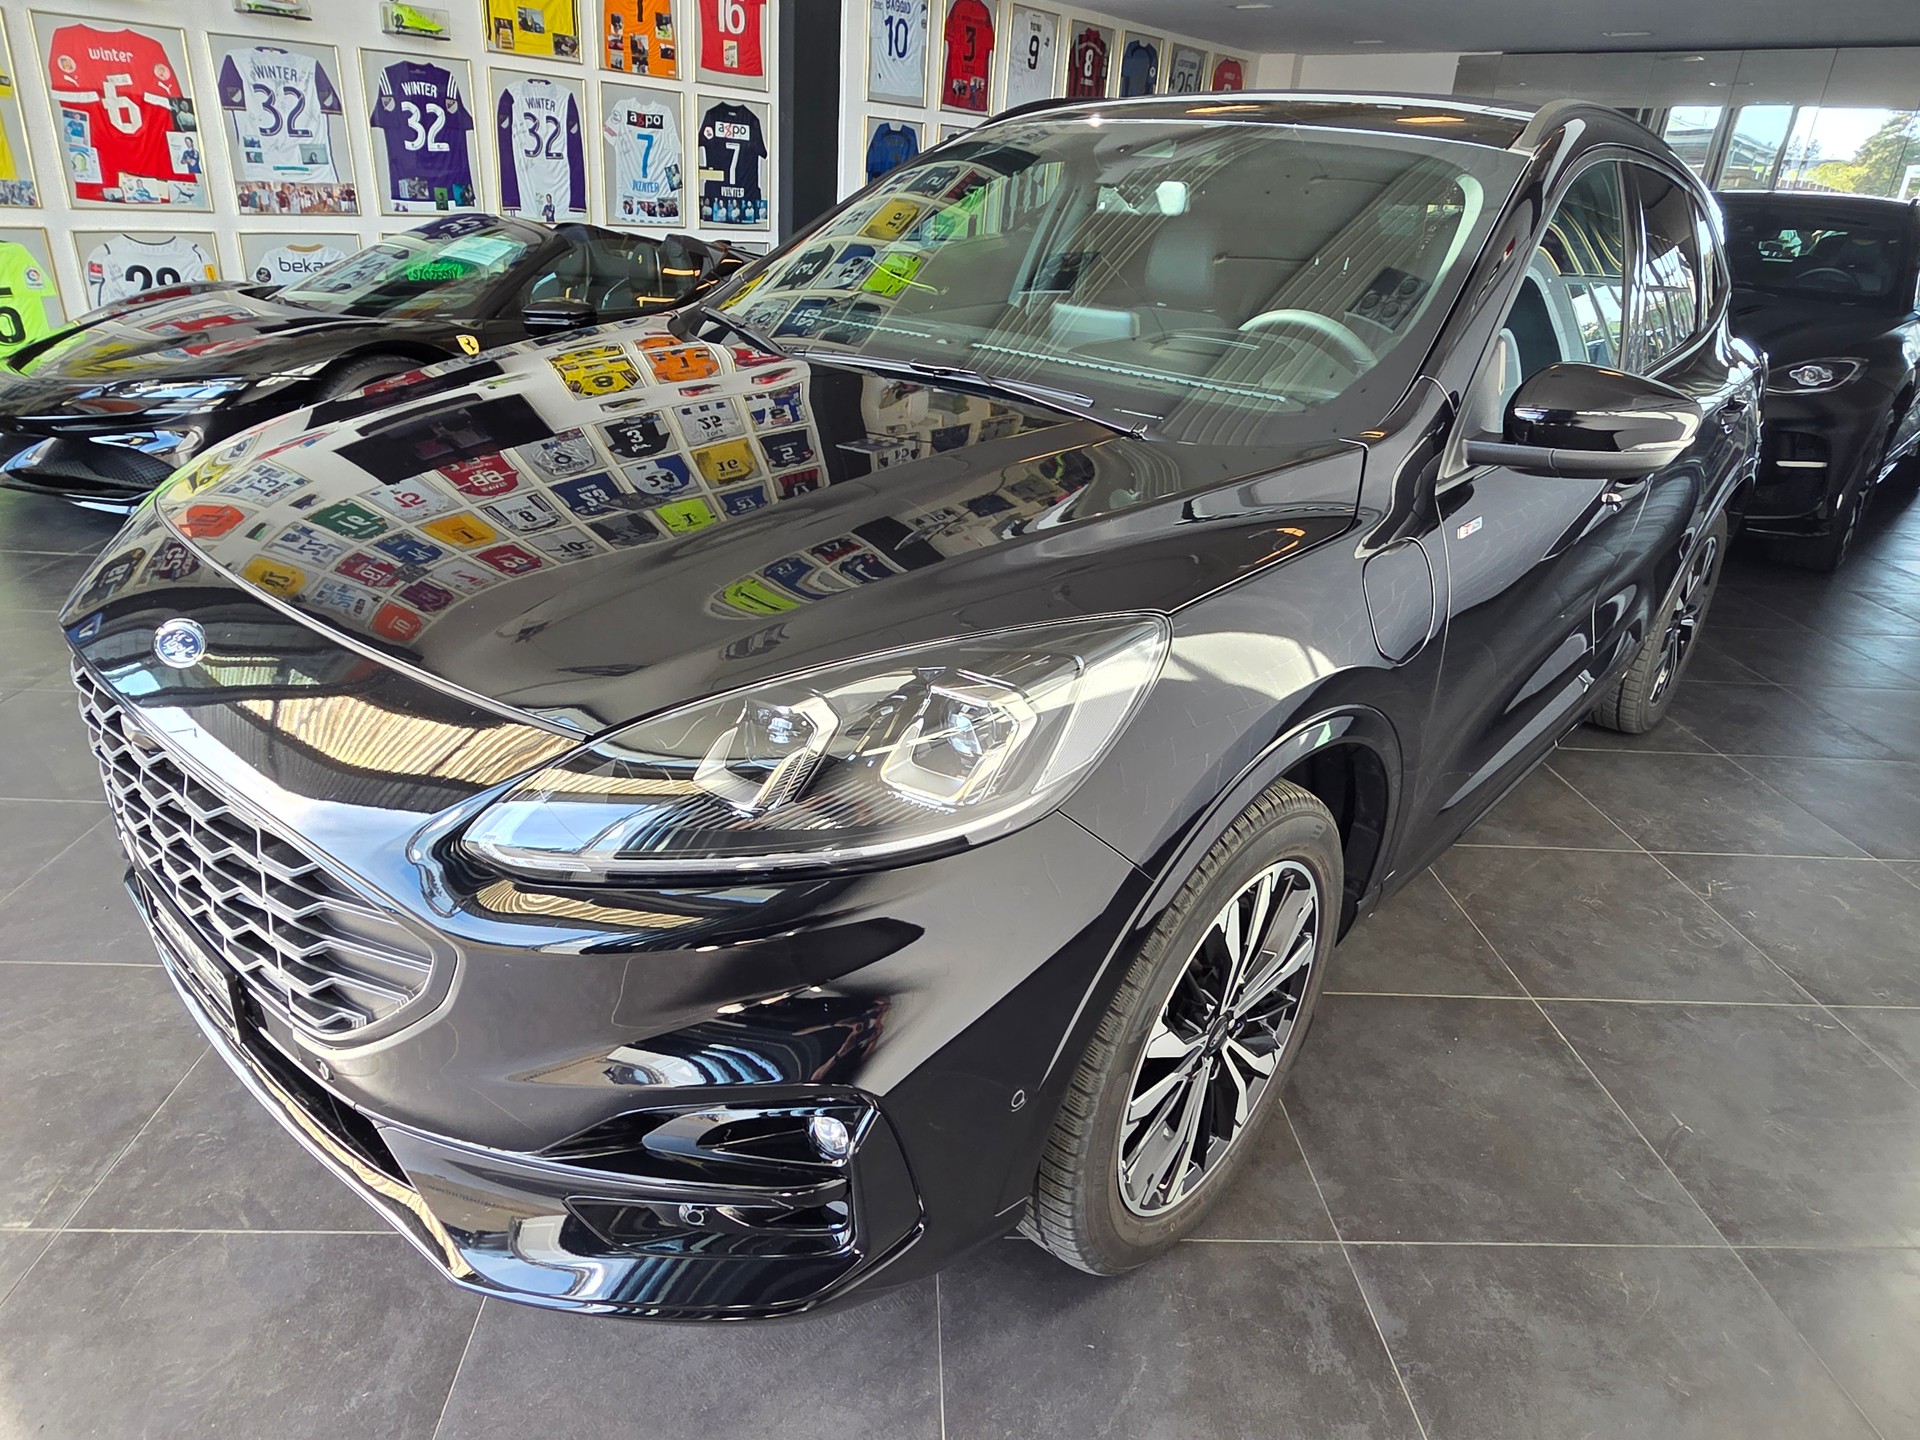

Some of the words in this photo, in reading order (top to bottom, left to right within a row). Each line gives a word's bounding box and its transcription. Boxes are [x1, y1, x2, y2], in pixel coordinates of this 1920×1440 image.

[717, 0, 746, 35] 16
[884, 15, 909, 59] 10
[963, 25, 976, 62] 3
[1027, 35, 1040, 70] 9
[88, 46, 134, 64] winter
[1083, 49, 1094, 77] 8
[253, 64, 298, 83] WINTER
[401, 81, 439, 98] WINTER
[102, 74, 142, 134] 6
[253, 83, 313, 138] 32
[525, 96, 556, 112] WINTER
[400, 101, 450, 152] 32
[522, 112, 563, 160] 32
[636, 133, 654, 178] 7
[724, 142, 741, 185] 7
[632, 181, 660, 194] WINTER
[720, 186, 745, 198] WINTER
